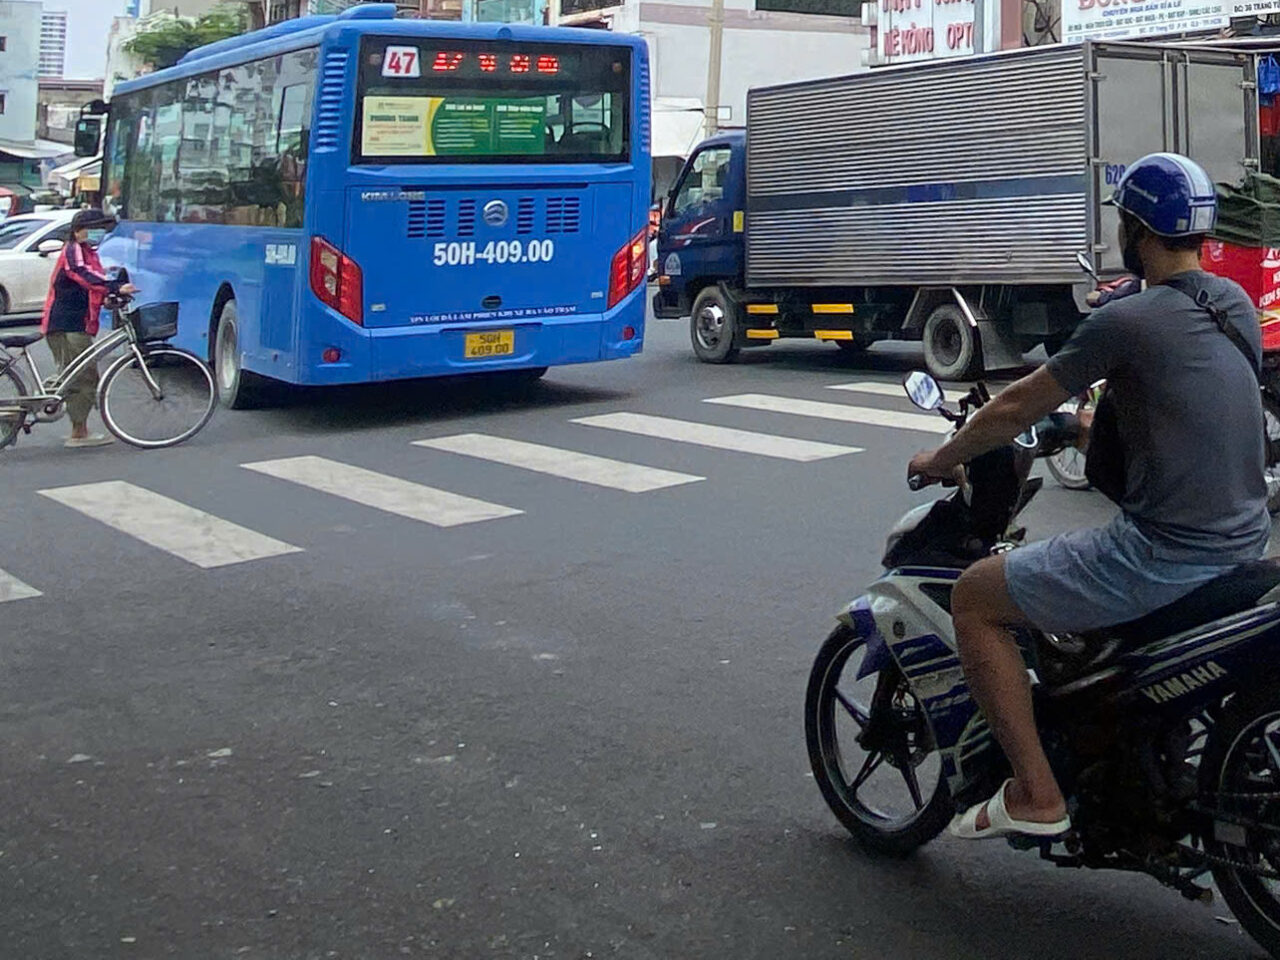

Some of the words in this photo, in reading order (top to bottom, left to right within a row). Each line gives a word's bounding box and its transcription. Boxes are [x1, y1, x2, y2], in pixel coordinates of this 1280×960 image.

[388, 52, 416, 74] 47
[434, 240, 554, 266] 50H-409.00
[1143, 660, 1228, 704] YAMAHA
